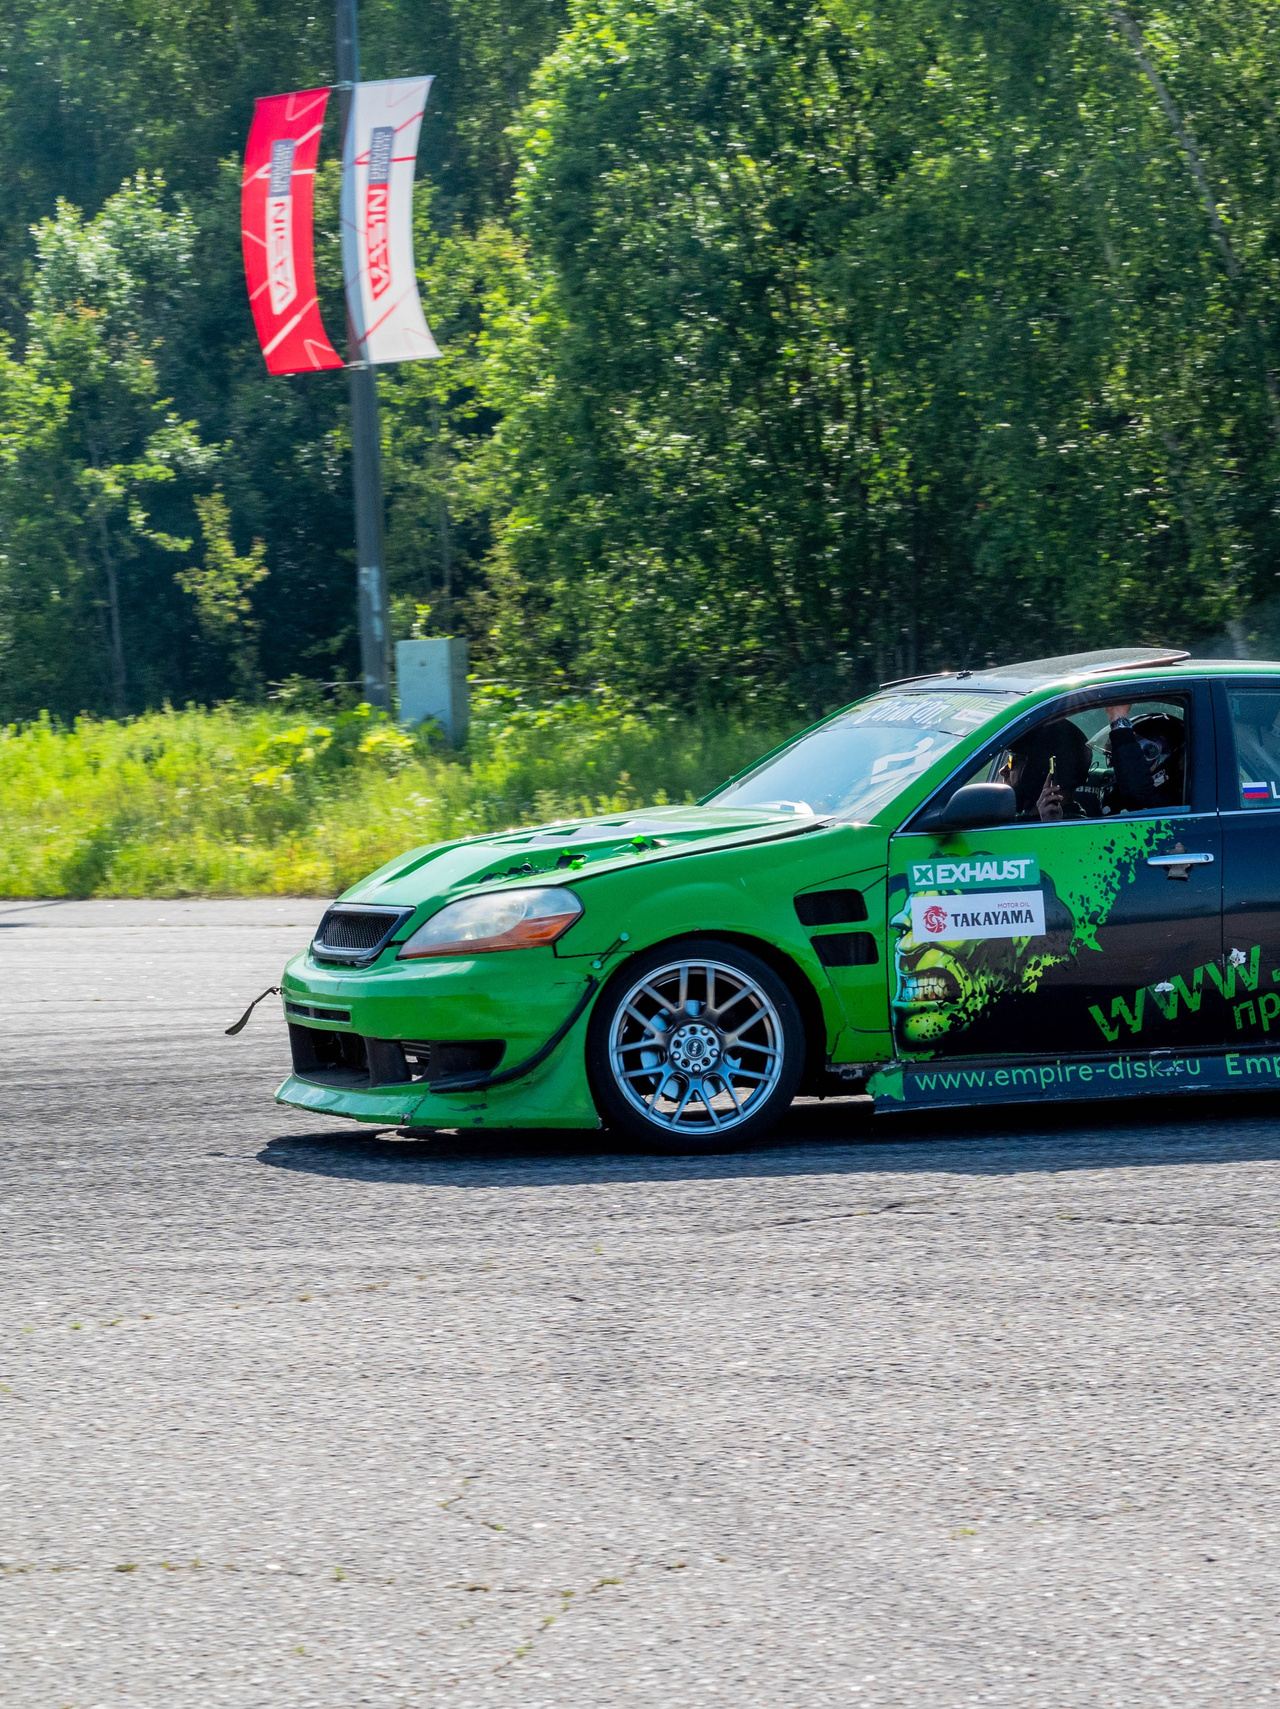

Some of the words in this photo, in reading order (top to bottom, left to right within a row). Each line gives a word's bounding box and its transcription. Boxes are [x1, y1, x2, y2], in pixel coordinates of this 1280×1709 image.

[936, 859, 1031, 884] EXHAUST
[950, 909, 1035, 927] TAKAYAMA
[914, 1056, 1200, 1089] www.empire-disk.ru
